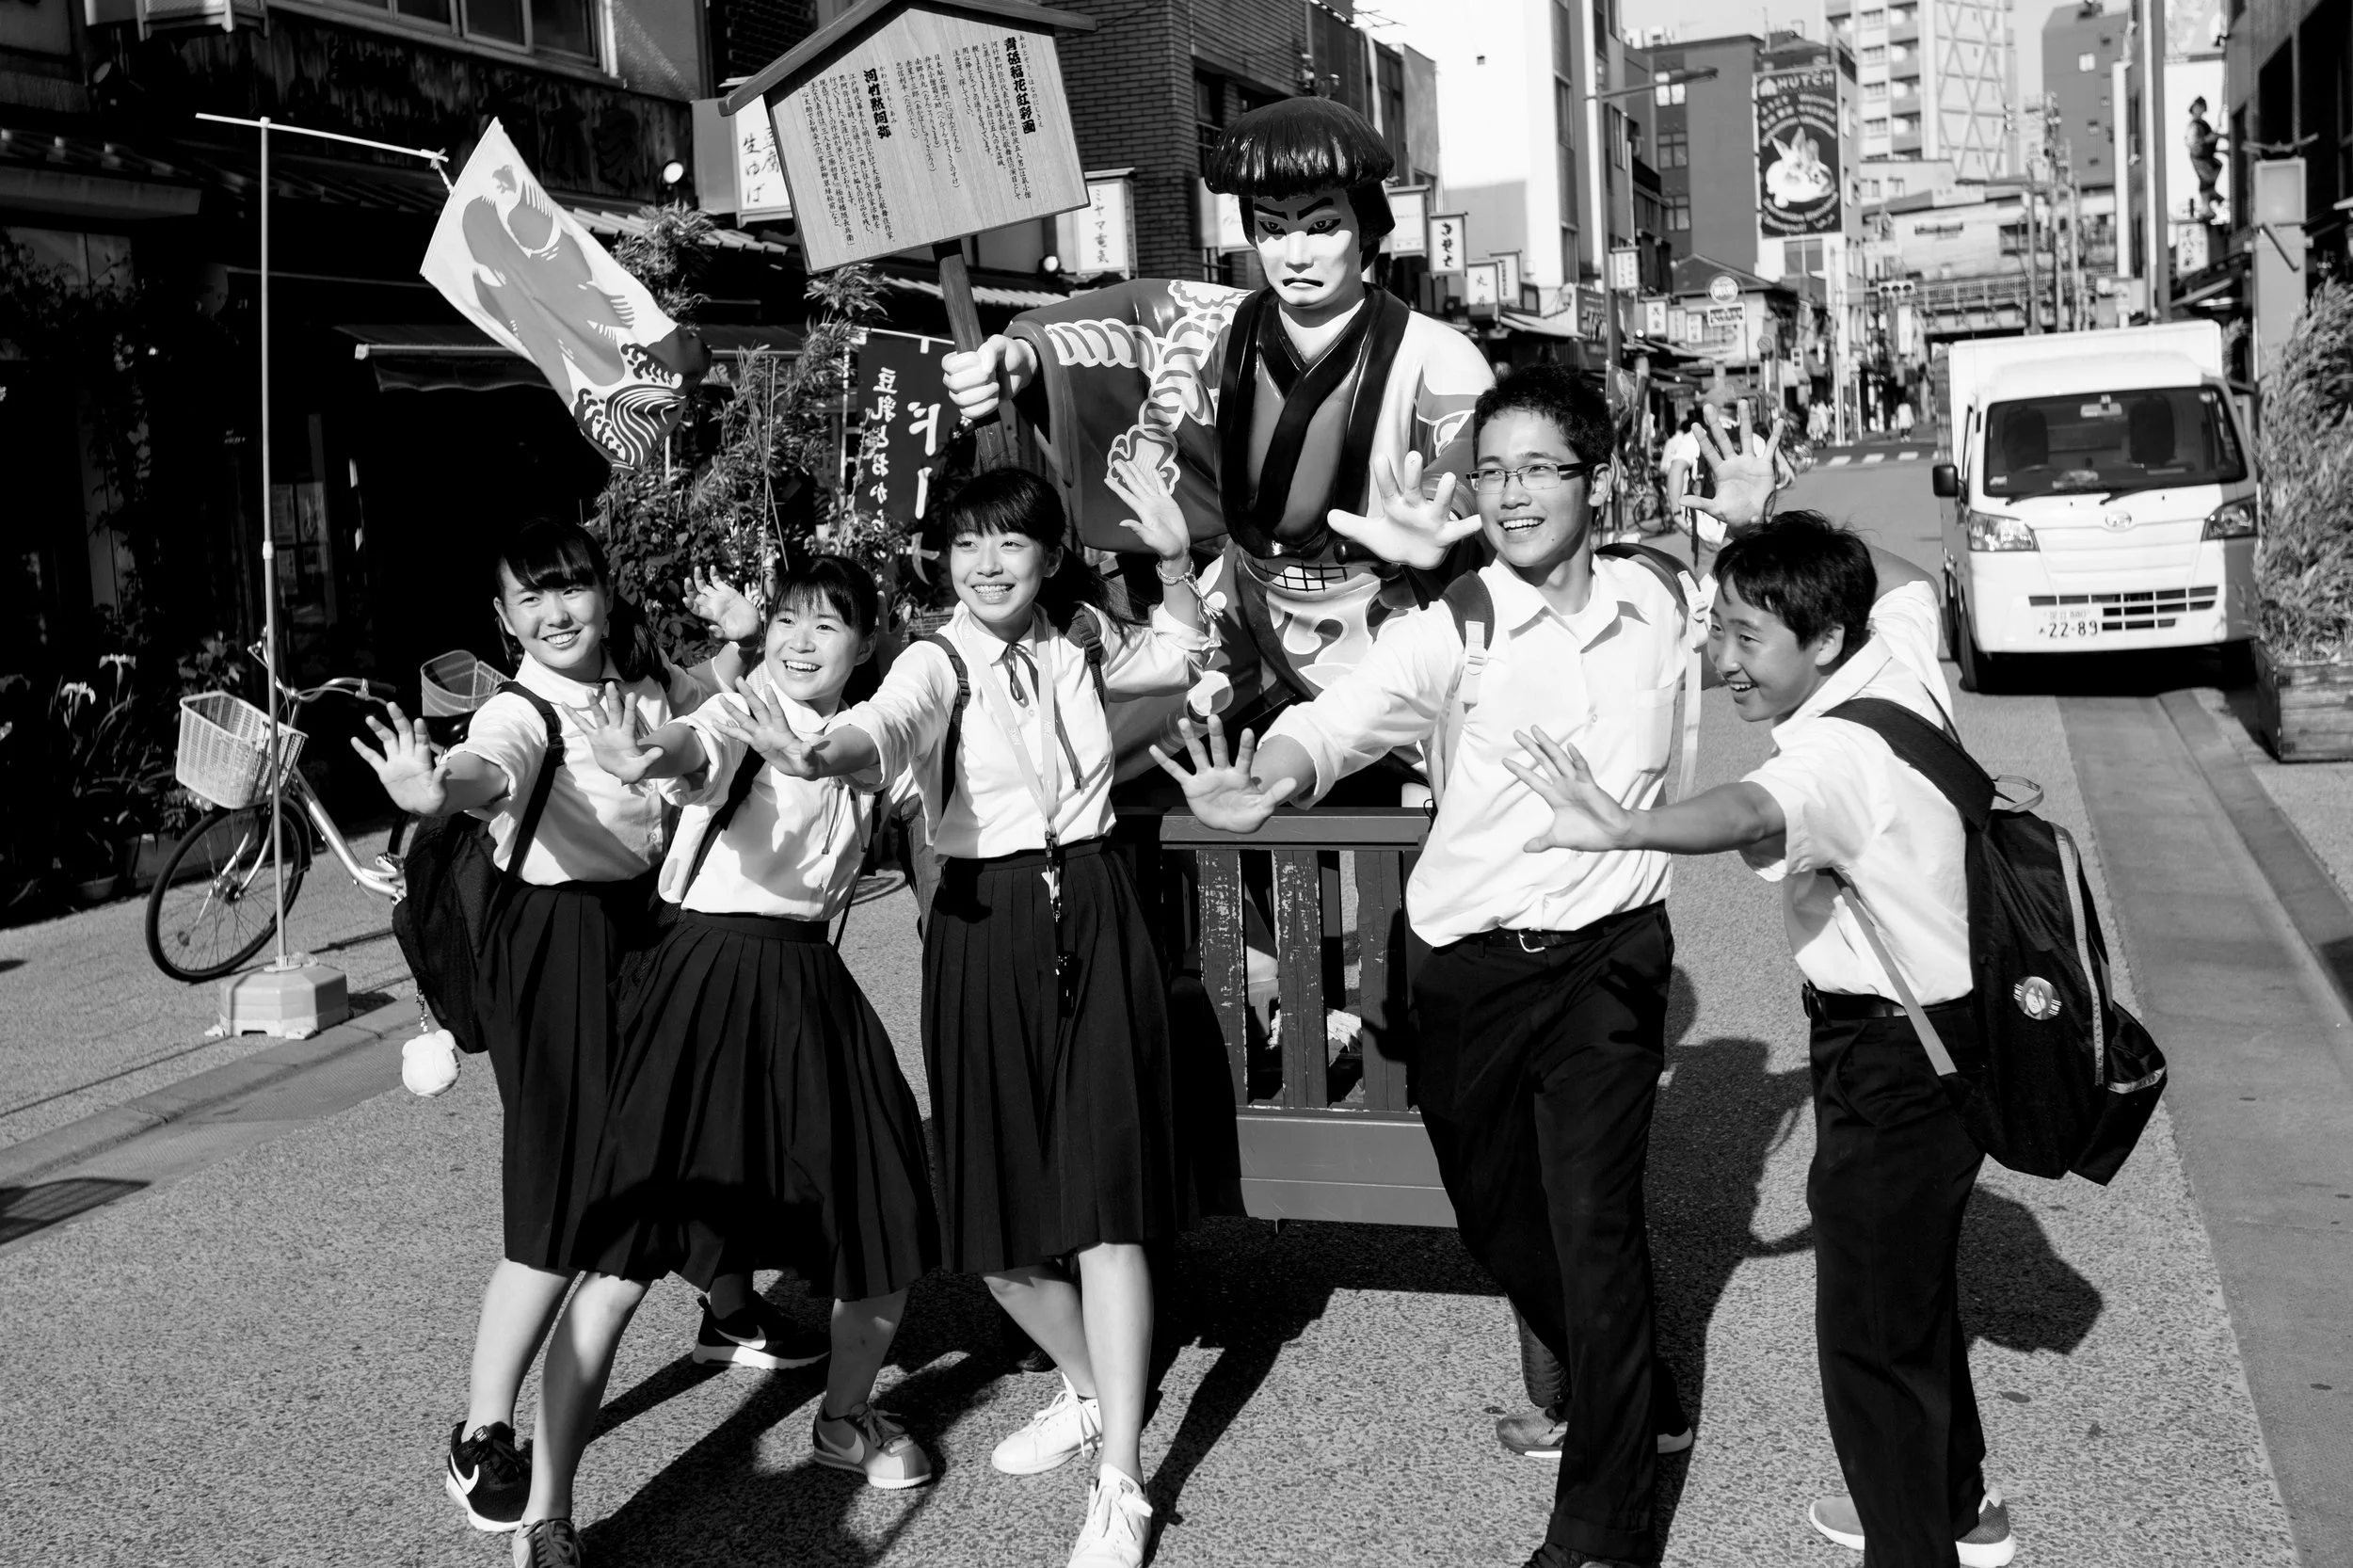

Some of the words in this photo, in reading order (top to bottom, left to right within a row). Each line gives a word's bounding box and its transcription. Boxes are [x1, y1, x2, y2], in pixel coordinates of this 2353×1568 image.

[862, 67, 891, 139] 河竹黙阿弥
[879, 65, 897, 123] かわたけもくあみ
